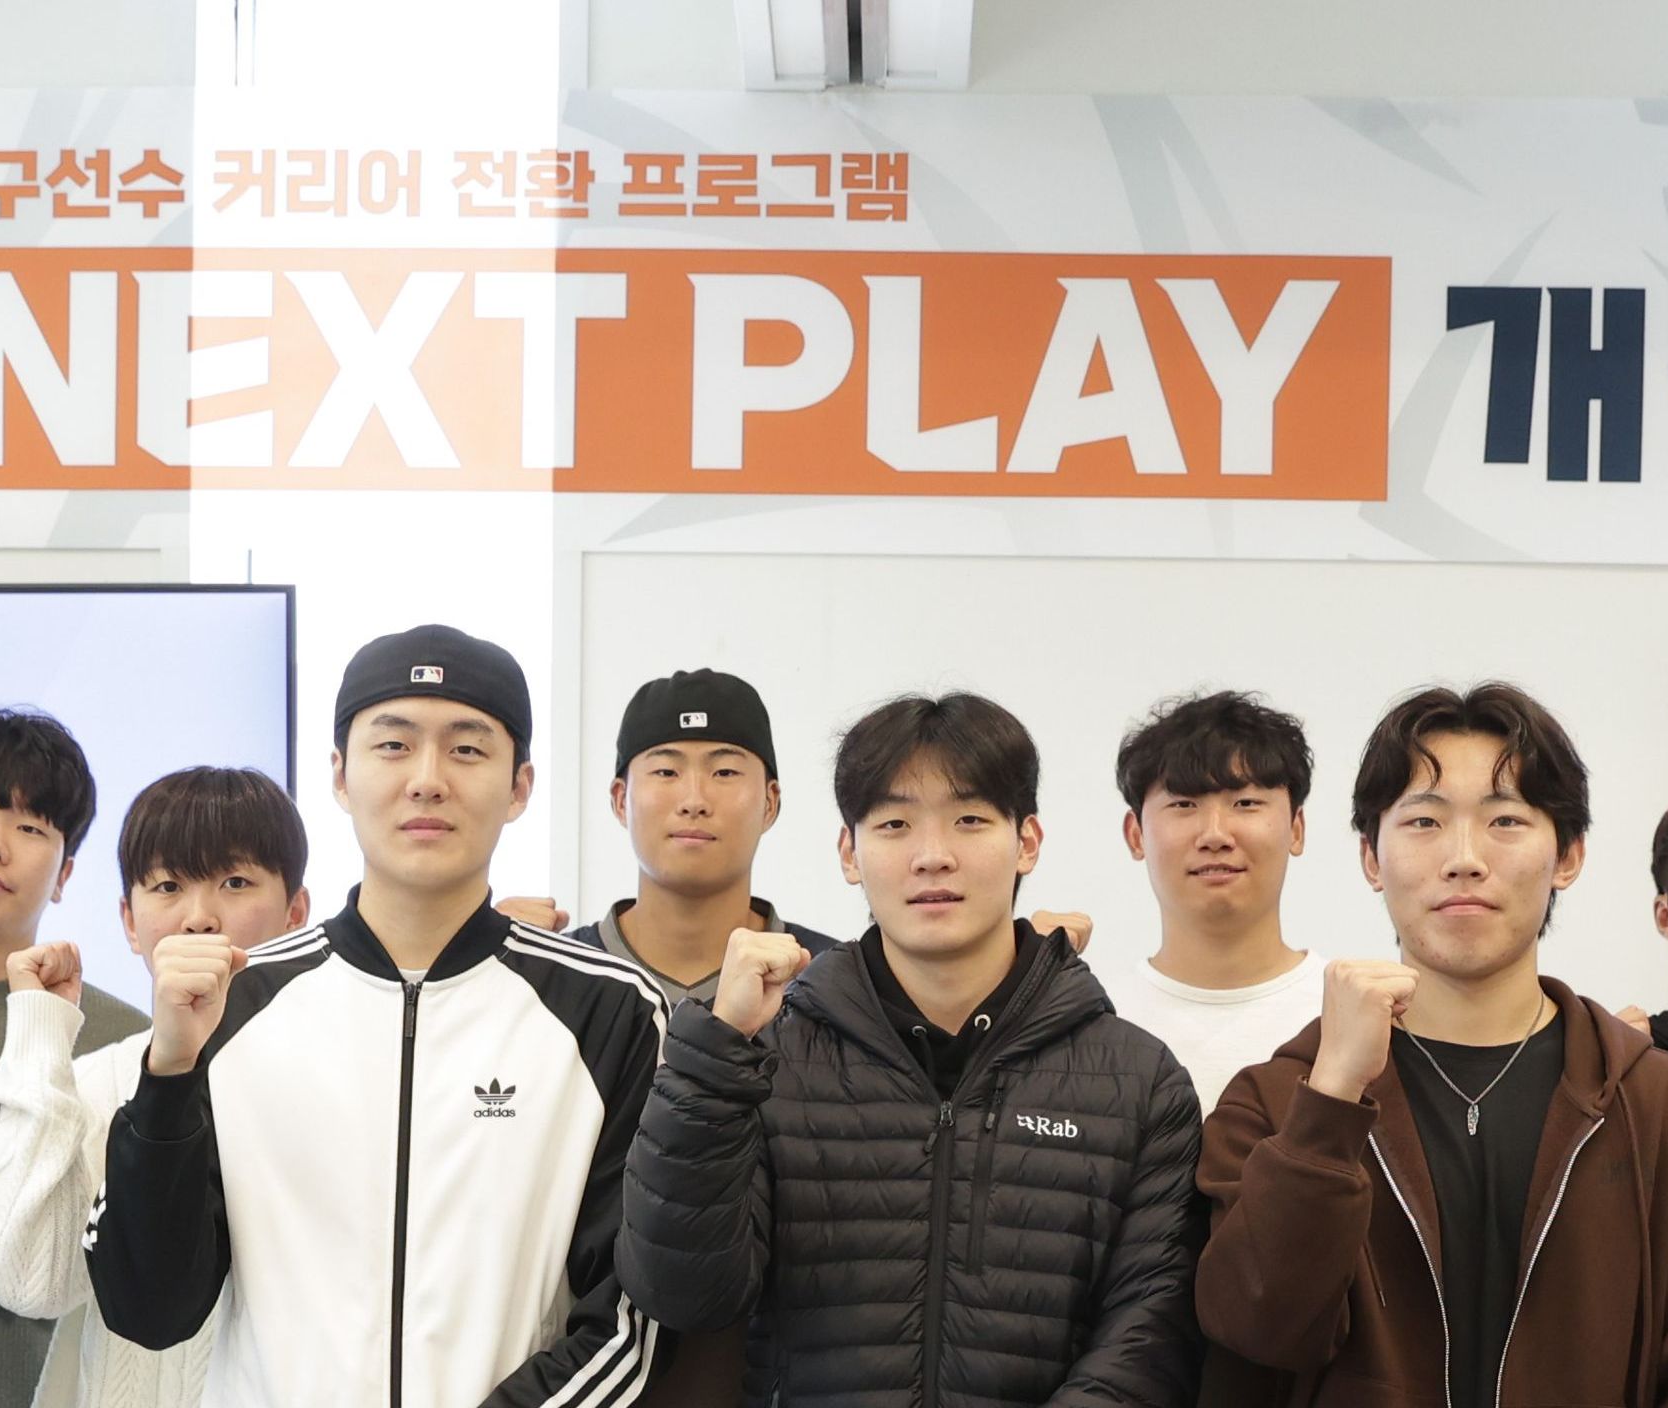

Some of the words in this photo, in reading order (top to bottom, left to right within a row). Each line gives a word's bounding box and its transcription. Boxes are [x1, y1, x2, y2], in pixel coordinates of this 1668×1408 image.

[212, 148, 422, 218] 커리어
[451, 150, 594, 218] 전환
[619, 151, 910, 222] 프로그램
[686, 273, 1341, 476] PLAY
[473, 1107, 516, 1118] adidas
[1035, 1115, 1078, 1138] Rab
